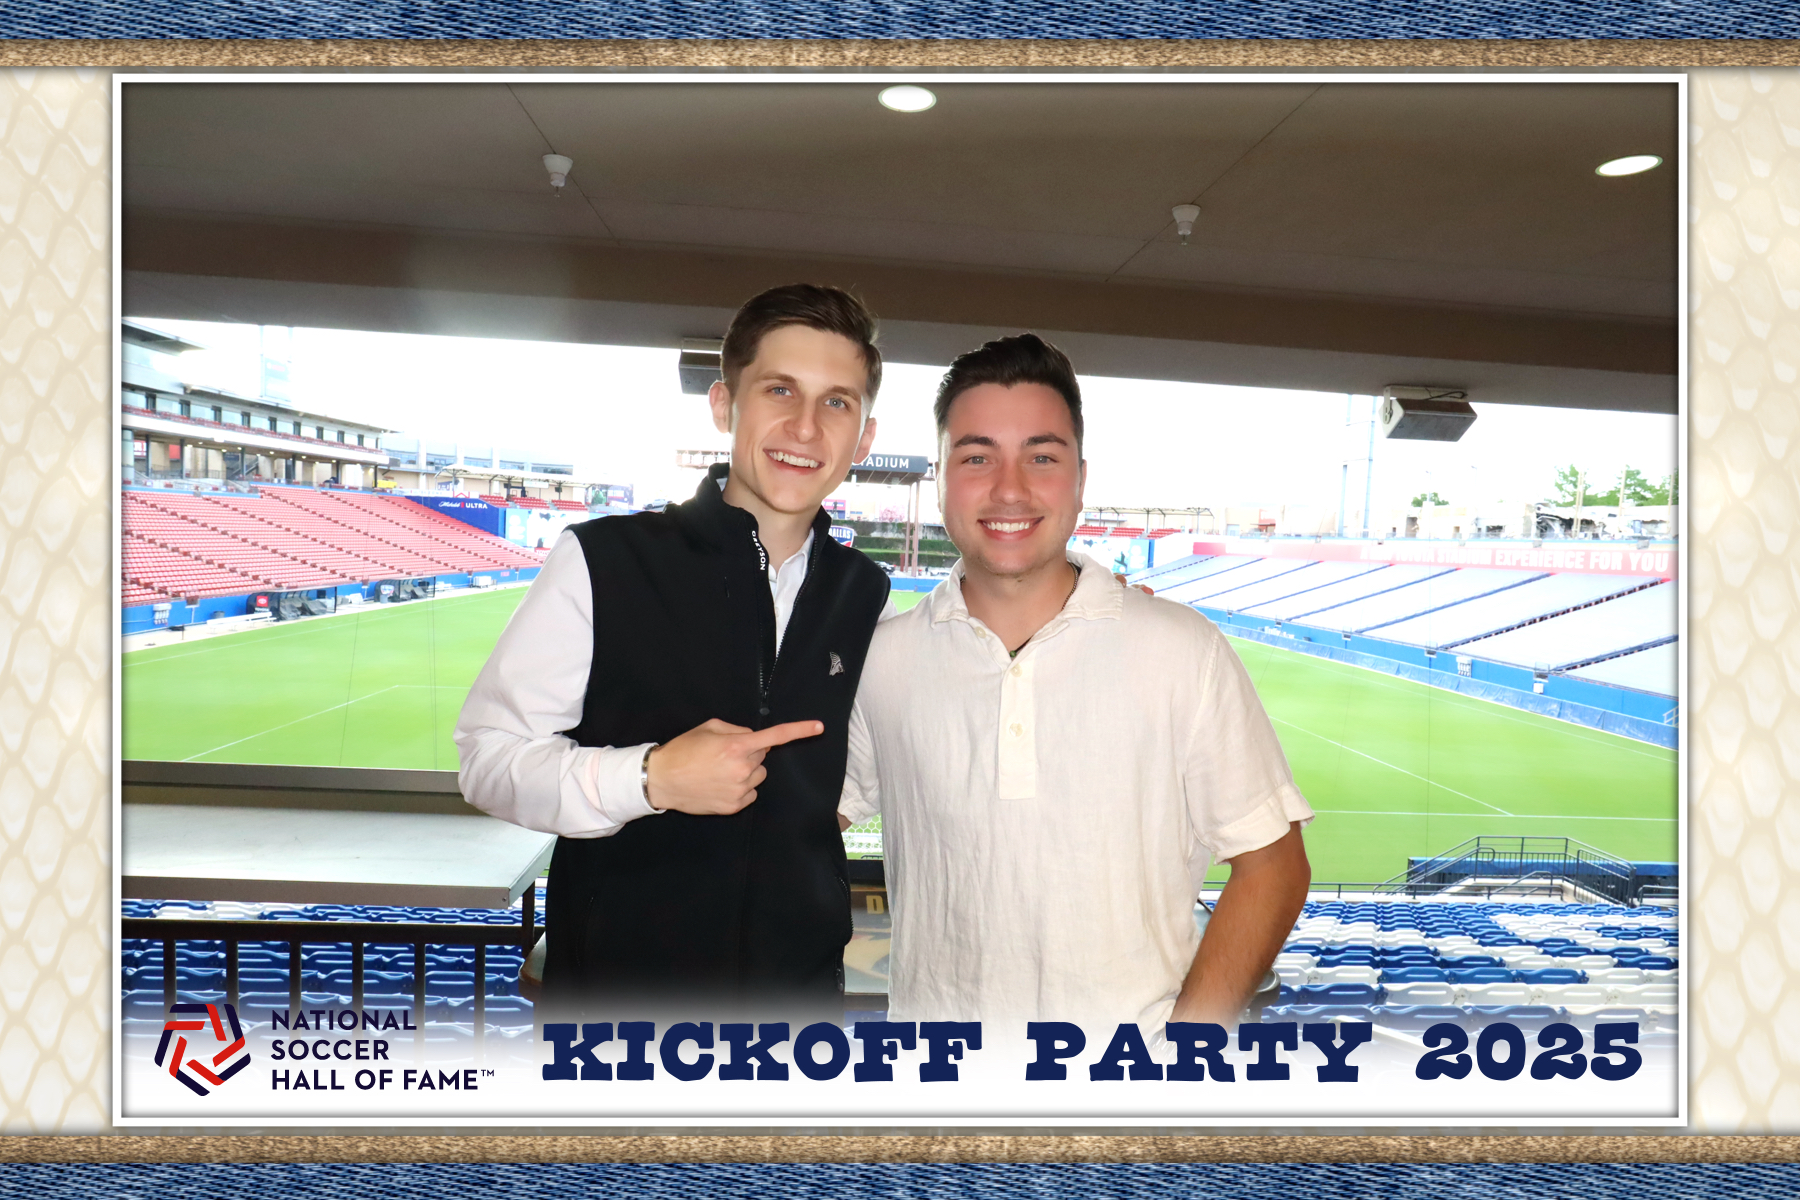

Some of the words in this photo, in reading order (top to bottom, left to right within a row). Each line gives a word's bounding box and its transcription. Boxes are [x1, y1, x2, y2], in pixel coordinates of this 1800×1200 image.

[854, 456, 909, 469] ADIUM
[751, 530, 766, 571] GREYSON
[1437, 548, 1492, 565] STADIUM
[1495, 550, 1585, 569] EXPERIENCE
[1589, 551, 1623, 571] FOR
[1629, 552, 1669, 573] YOU
